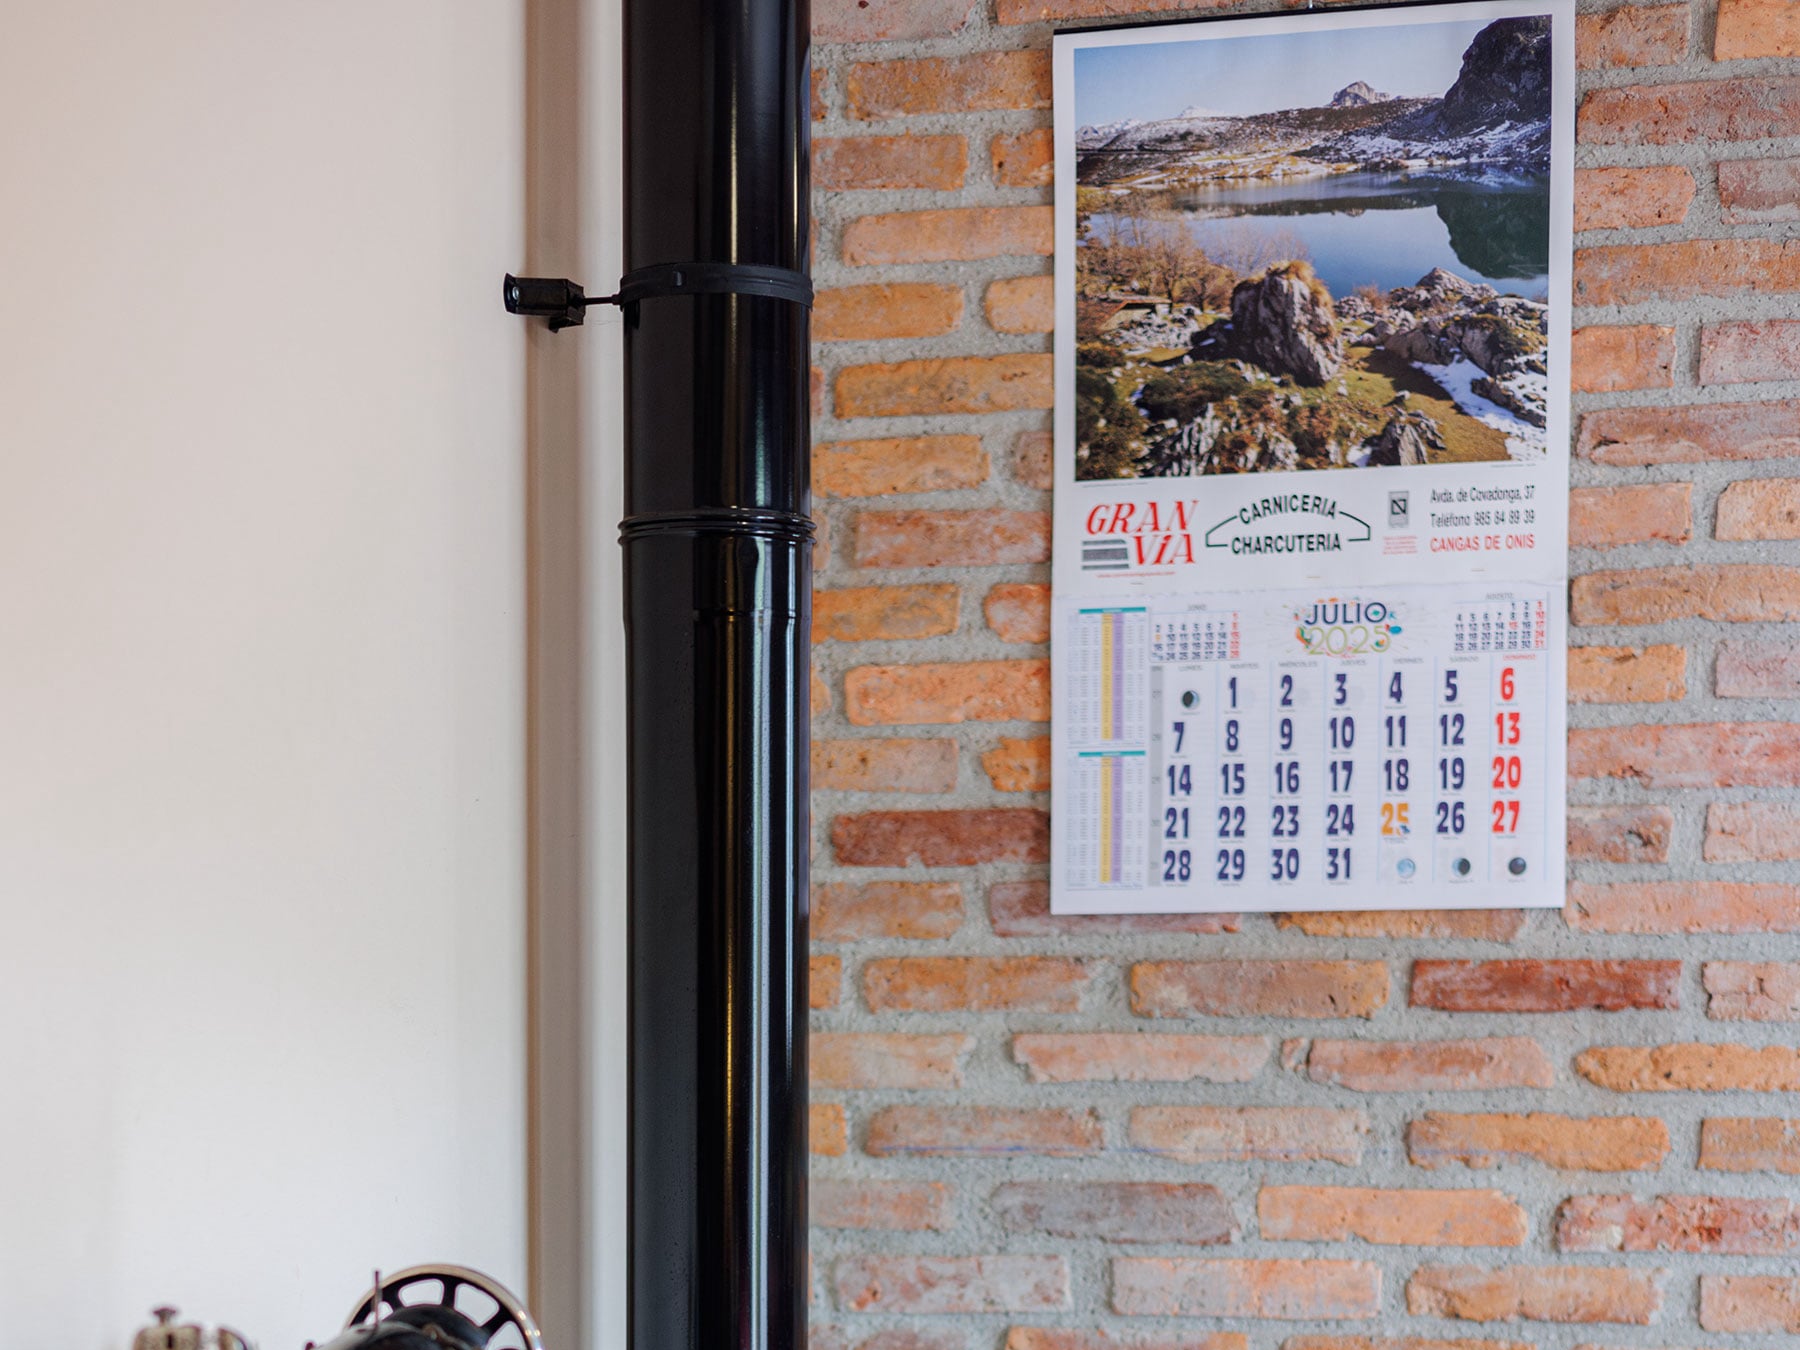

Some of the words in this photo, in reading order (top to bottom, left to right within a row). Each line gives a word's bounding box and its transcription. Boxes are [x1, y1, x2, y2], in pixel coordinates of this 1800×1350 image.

[1086, 501, 1197, 538] GRAN
[1237, 494, 1336, 525] CARNICERIA
[1232, 533, 1341, 554] CHARCUTERIA
[1430, 536, 1479, 552] CANGAS
[1485, 536, 1500, 550] DE
[1303, 602, 1387, 625] JULIO
[1307, 625, 1391, 655] 2025
[1229, 677, 1237, 708] 1
[1281, 675, 1293, 707] 2
[1335, 673, 1347, 706] 3
[1389, 672, 1402, 703] 4
[1445, 670, 1457, 702] 5
[1501, 668, 1514, 701] 6
[1173, 722, 1184, 753] 7
[1226, 720, 1239, 752] 8
[1280, 718, 1293, 751] 9
[1330, 716, 1354, 749] 10
[1385, 715, 1406, 747] 11
[1440, 713, 1464, 746] 12
[1496, 712, 1520, 745] 13
[1167, 764, 1192, 796] 14
[1221, 763, 1245, 795] 15
[1275, 761, 1299, 794] 16
[1330, 761, 1353, 792] 17
[1384, 759, 1409, 791] 18
[1440, 757, 1464, 790] 19
[1492, 756, 1521, 789] 20
[1165, 807, 1189, 839] 21
[1218, 806, 1245, 838] 22
[1272, 805, 1299, 837] 23
[1326, 804, 1354, 836] 24
[1381, 803, 1410, 835] 25
[1436, 801, 1464, 834] 26
[1492, 800, 1520, 833] 27
[1163, 850, 1191, 882] 28
[1217, 849, 1245, 881] 29
[1271, 848, 1299, 880] 30
[1327, 848, 1351, 880] 31
